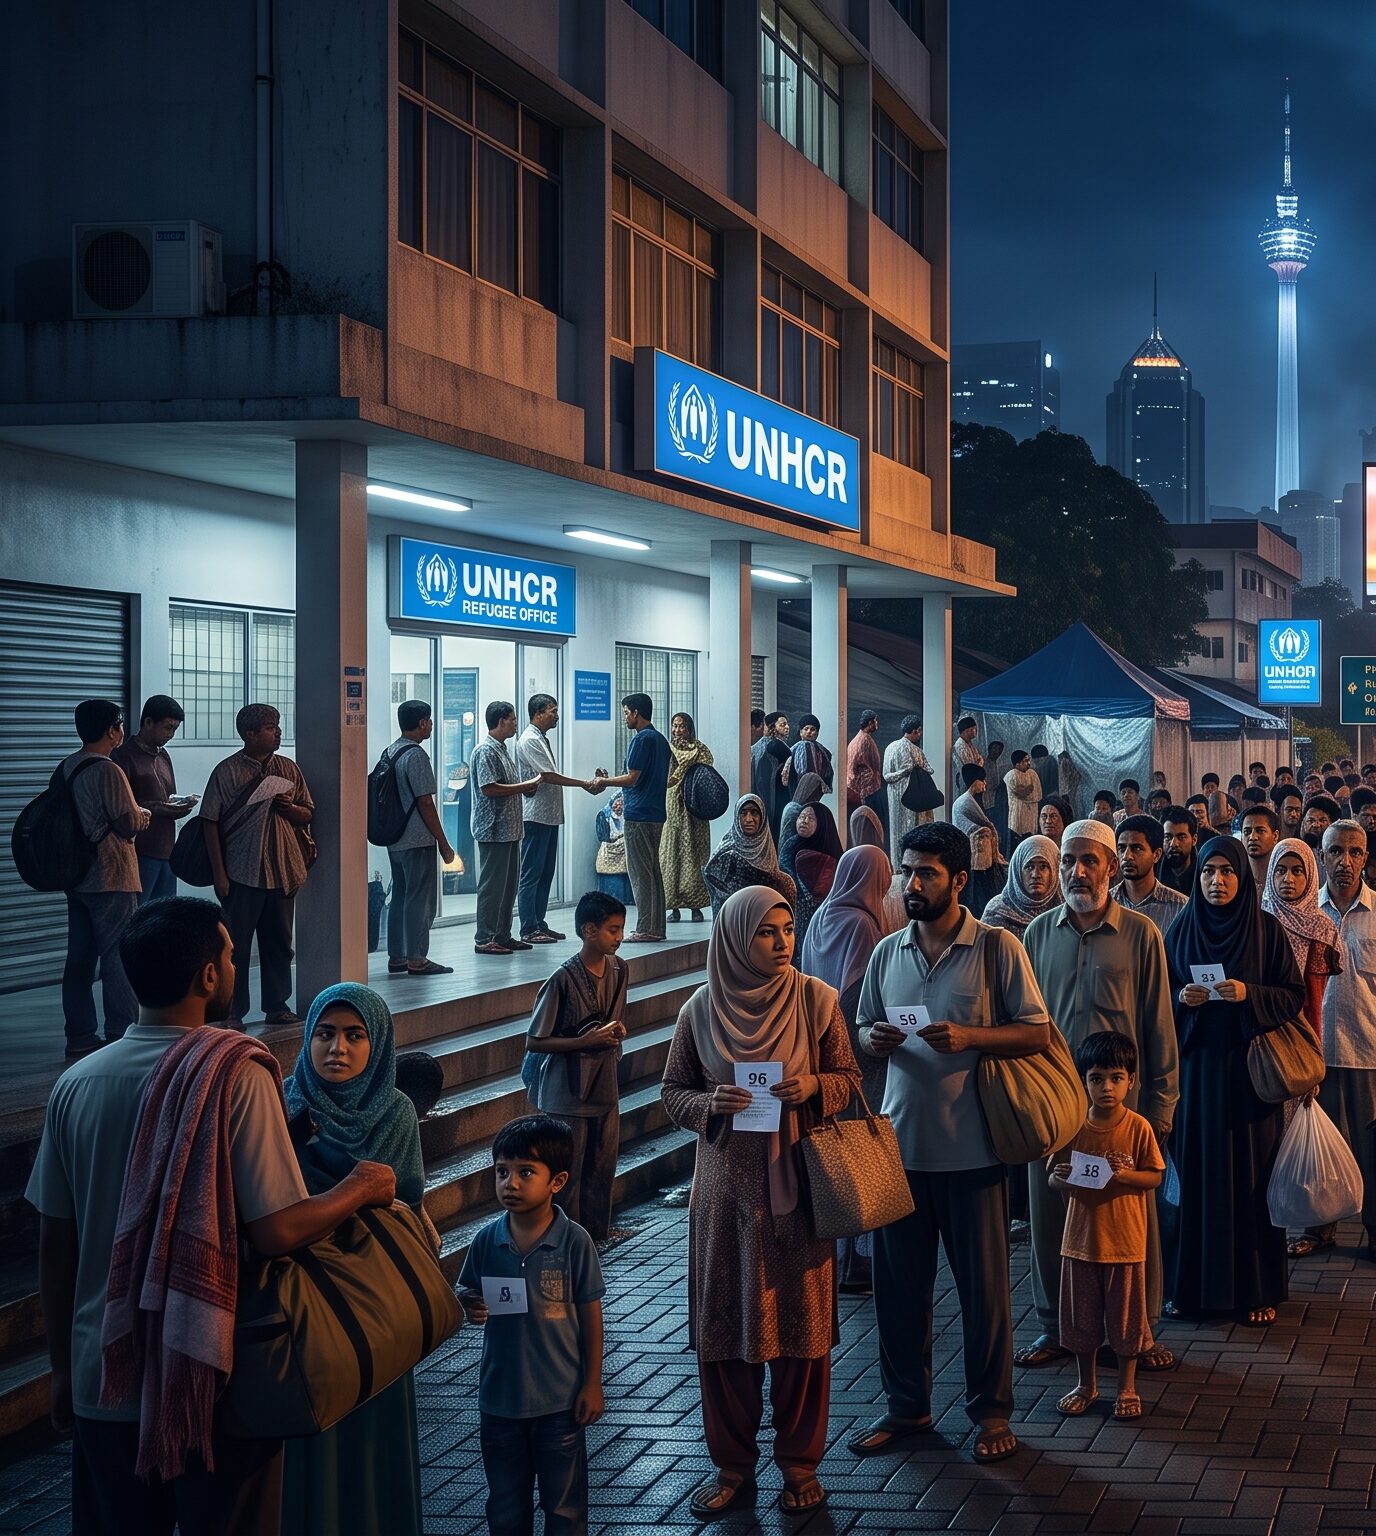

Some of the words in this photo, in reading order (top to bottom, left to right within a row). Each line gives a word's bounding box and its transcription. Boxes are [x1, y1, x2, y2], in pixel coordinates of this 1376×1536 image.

[727, 410, 847, 504] UNHCR
[462, 562, 558, 607] UNHCR
[462, 600, 516, 620] REFUGEE
[519, 607, 558, 625] OFFICE
[748, 1072, 767, 1085] 96
